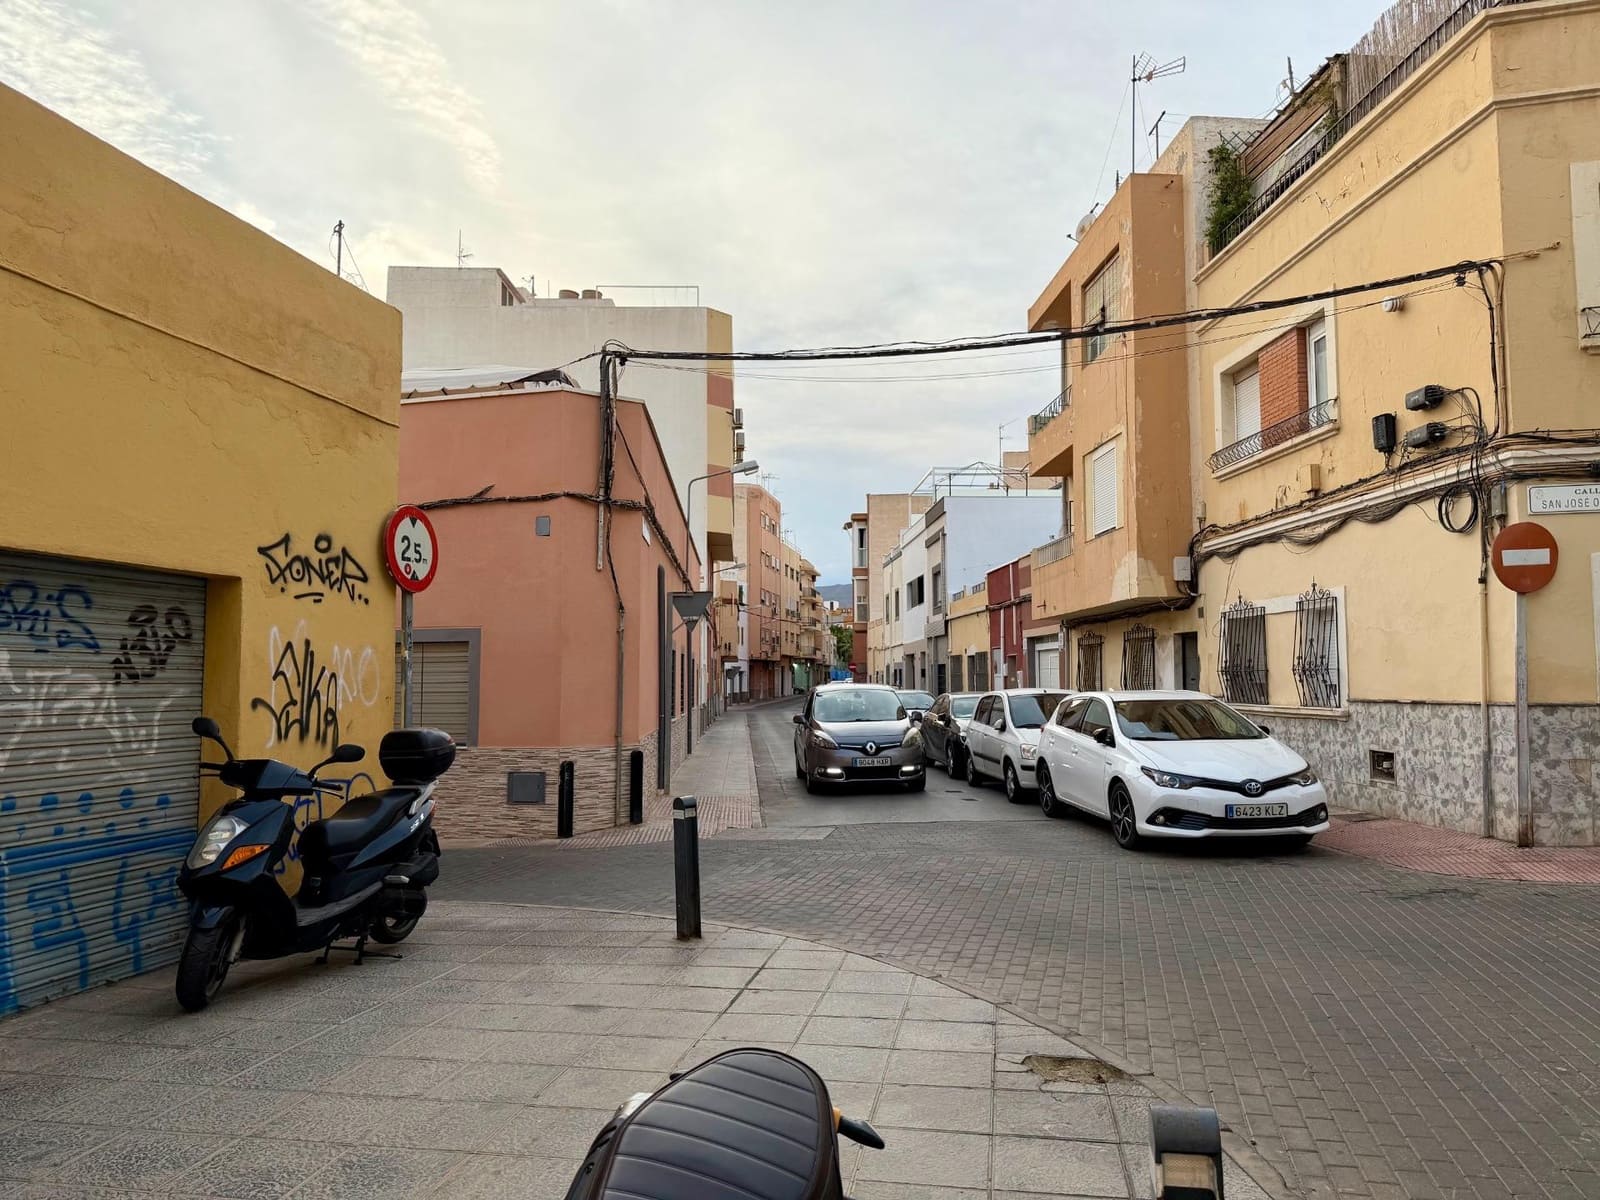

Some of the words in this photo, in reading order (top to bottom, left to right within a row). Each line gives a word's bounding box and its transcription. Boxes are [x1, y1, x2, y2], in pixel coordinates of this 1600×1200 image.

[1541, 500, 1562, 509] SAN
[1235, 806, 1262, 817] 6423
[1264, 805, 1284, 816] KLZ
